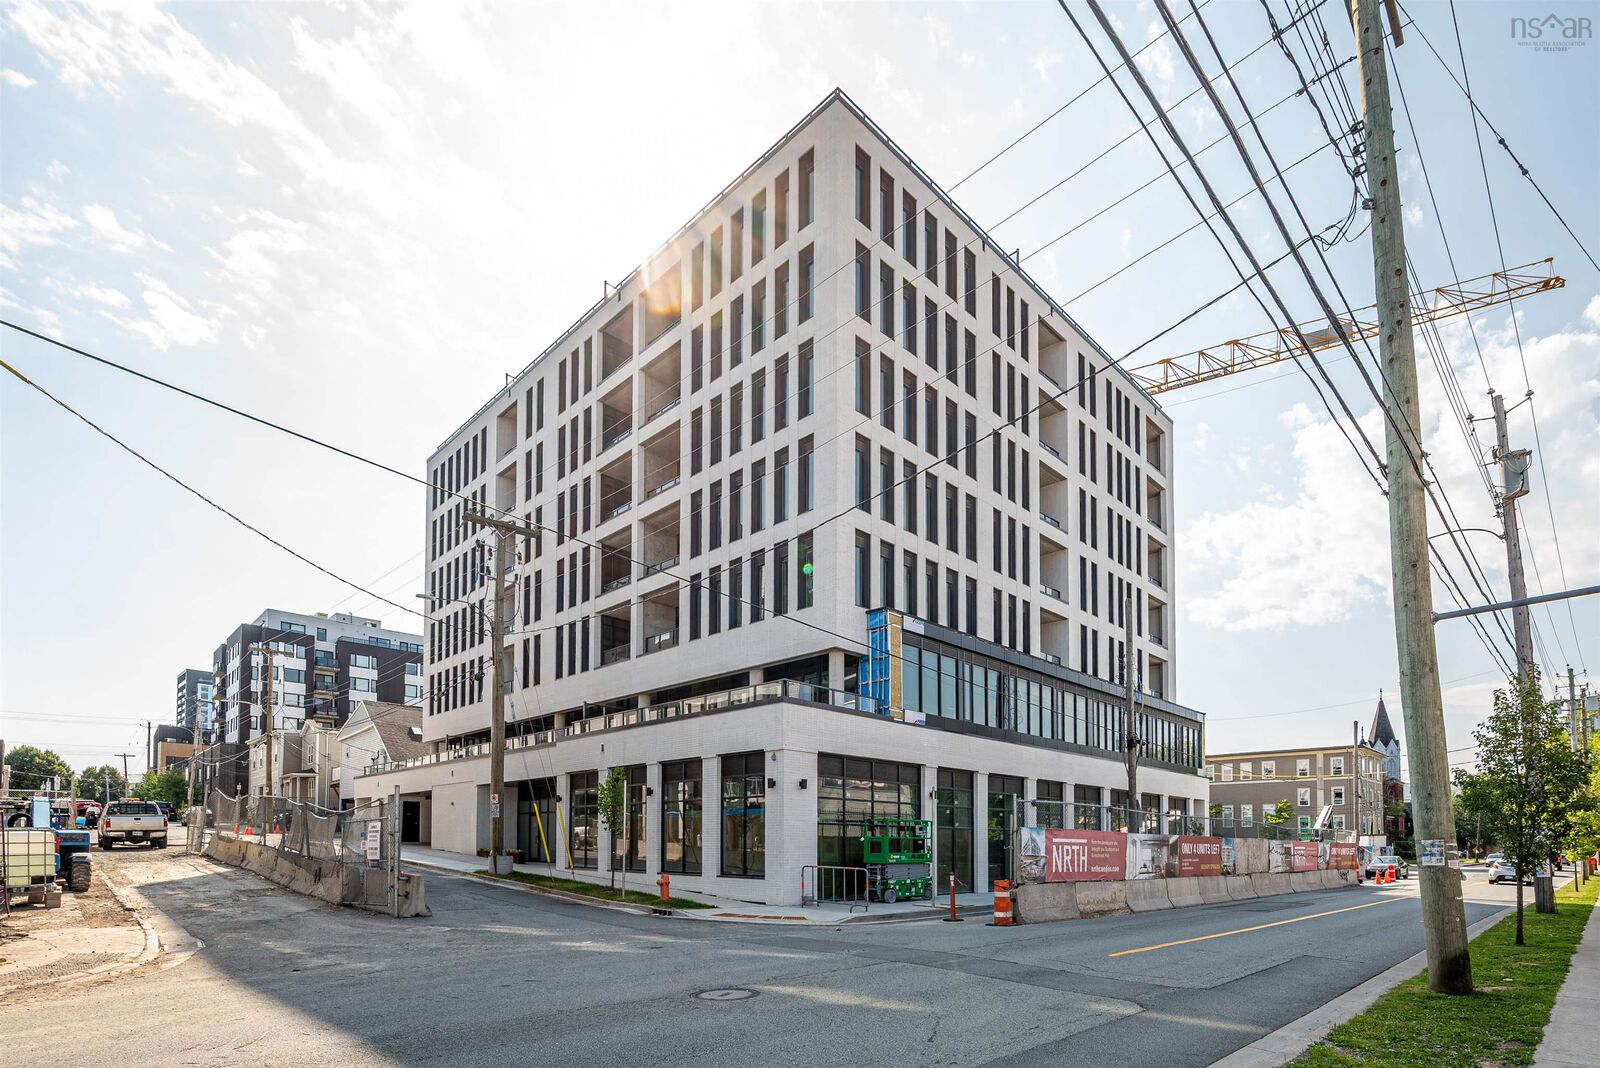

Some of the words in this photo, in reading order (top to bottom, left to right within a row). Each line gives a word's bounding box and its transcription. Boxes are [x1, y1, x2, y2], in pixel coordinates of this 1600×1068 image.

[1052, 845, 1088, 873] NRTH
[1181, 843, 1193, 854] ONLY
[1197, 843, 1211, 855] UNITS
[1211, 844, 1220, 855] LEFT
